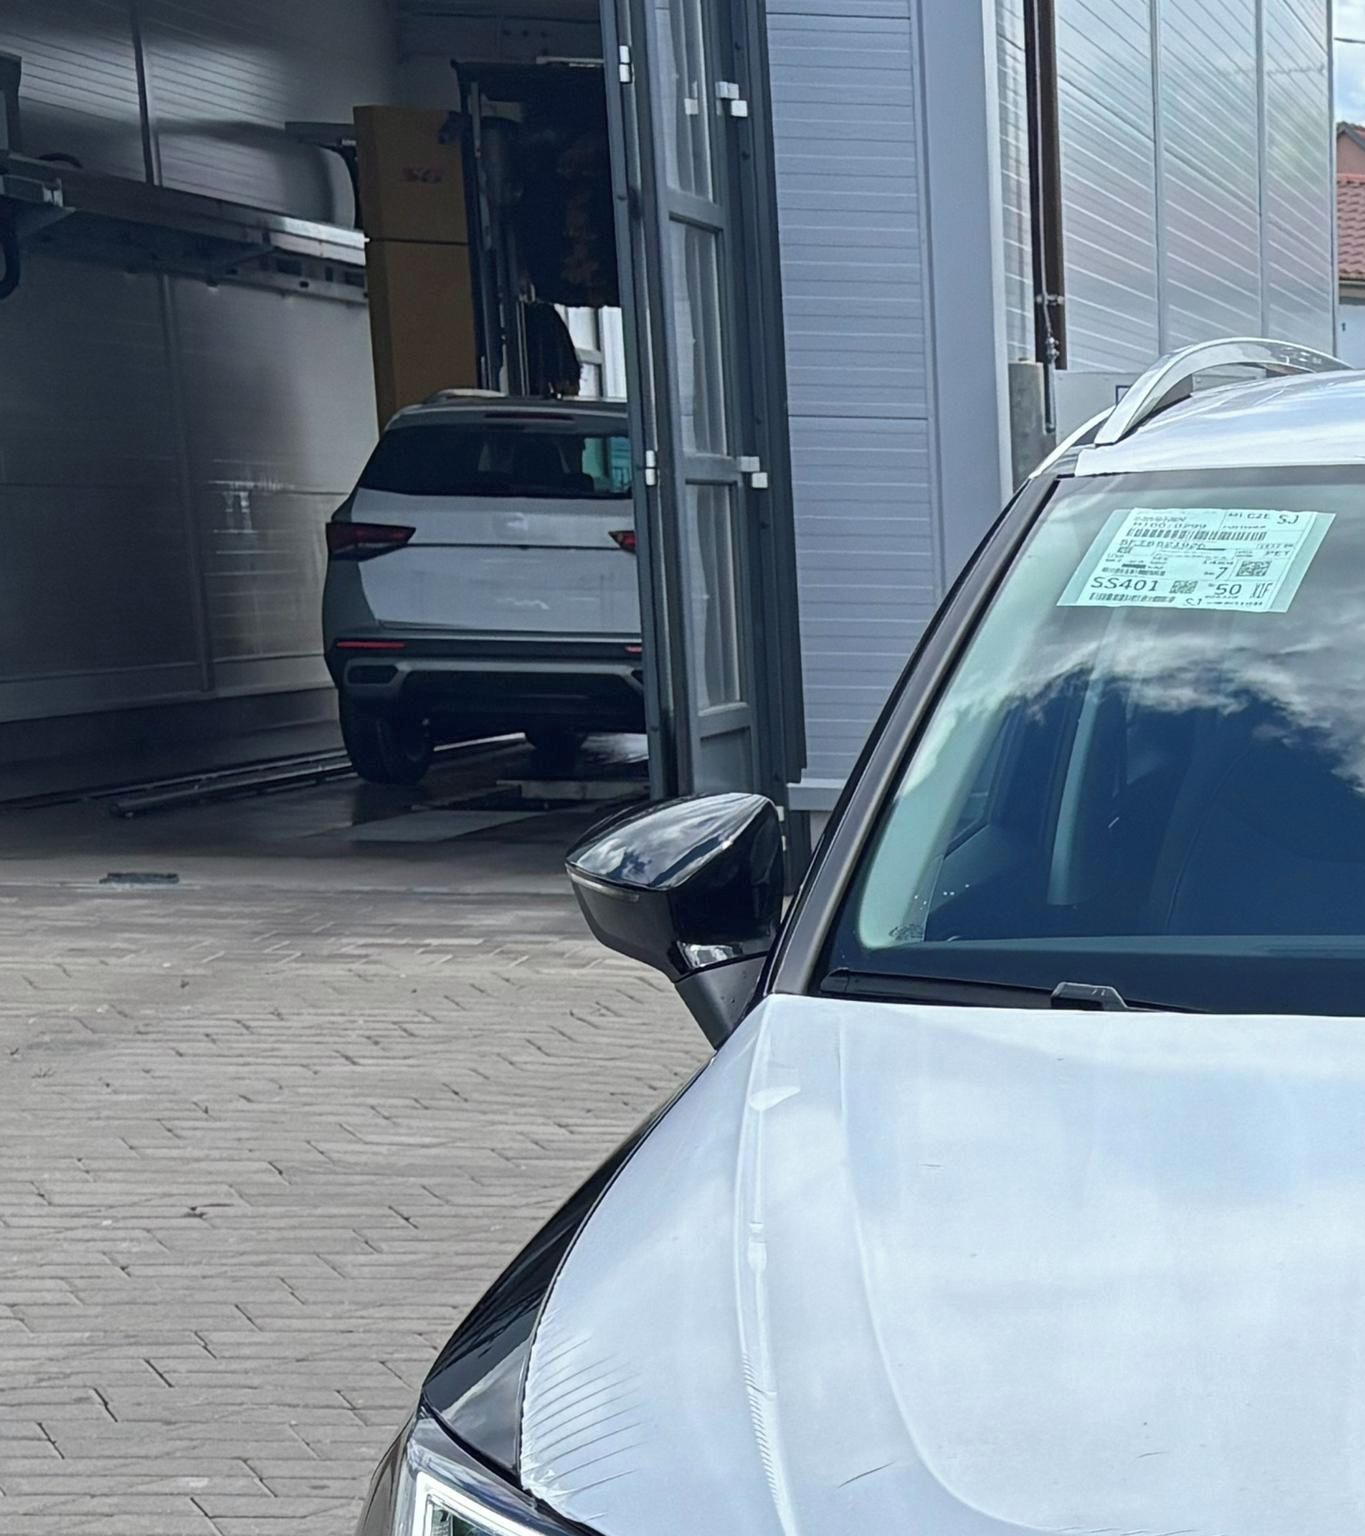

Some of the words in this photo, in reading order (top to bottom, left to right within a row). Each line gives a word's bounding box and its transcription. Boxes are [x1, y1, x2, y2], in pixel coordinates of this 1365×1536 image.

[1276, 514, 1300, 525] SJ
[1215, 566, 1228, 580] 7
[1090, 576, 1158, 592] SS401
[1214, 583, 1242, 596] 50
